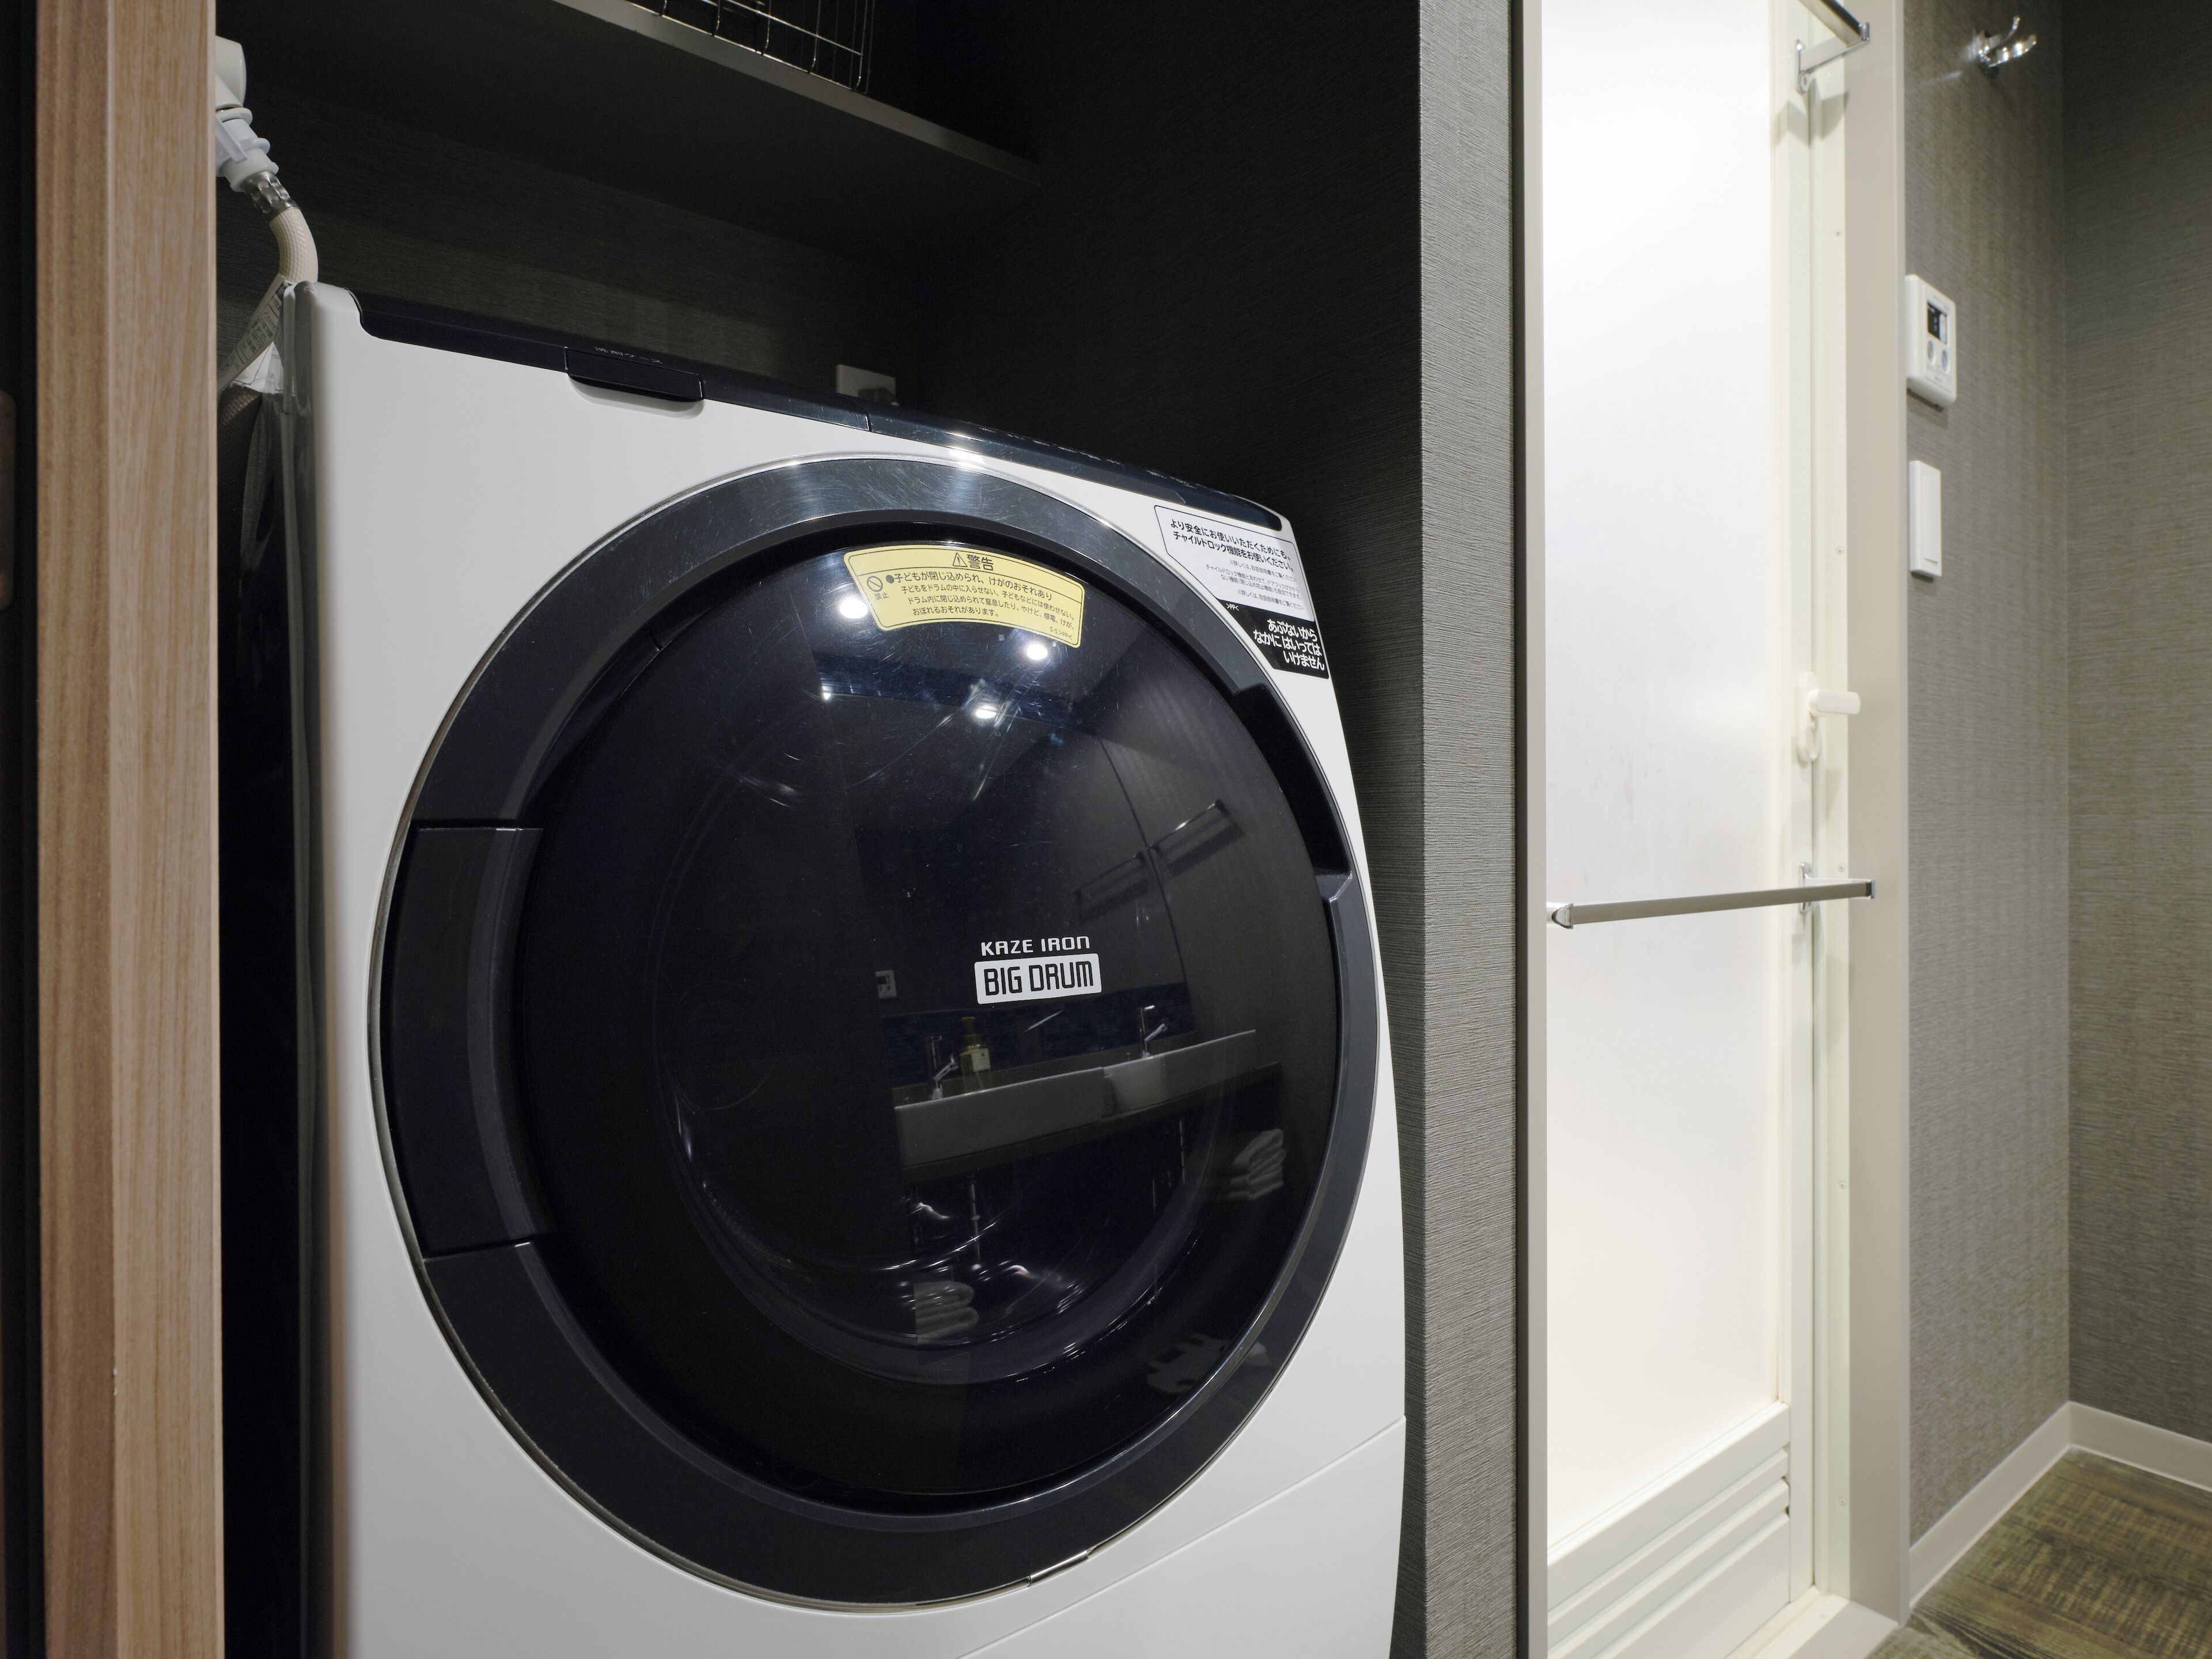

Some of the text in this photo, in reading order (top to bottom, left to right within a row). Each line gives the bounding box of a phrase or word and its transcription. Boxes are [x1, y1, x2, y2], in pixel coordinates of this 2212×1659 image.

[1171, 518, 1291, 561] より安全にお使いいただくためにも、
[1173, 531, 1294, 572] チャイルドロック機能をお使いください。
[967, 554, 994, 571] 警告
[873, 592, 889, 600] 禁止
[912, 606, 999, 617] おぼれるおそれがあります。
[1267, 618, 1318, 642] あぶないから
[1282, 650, 1325, 671] いけません
[980, 935, 1090, 956] KAZE IRON
[983, 960, 1094, 996] BIG DRUM
